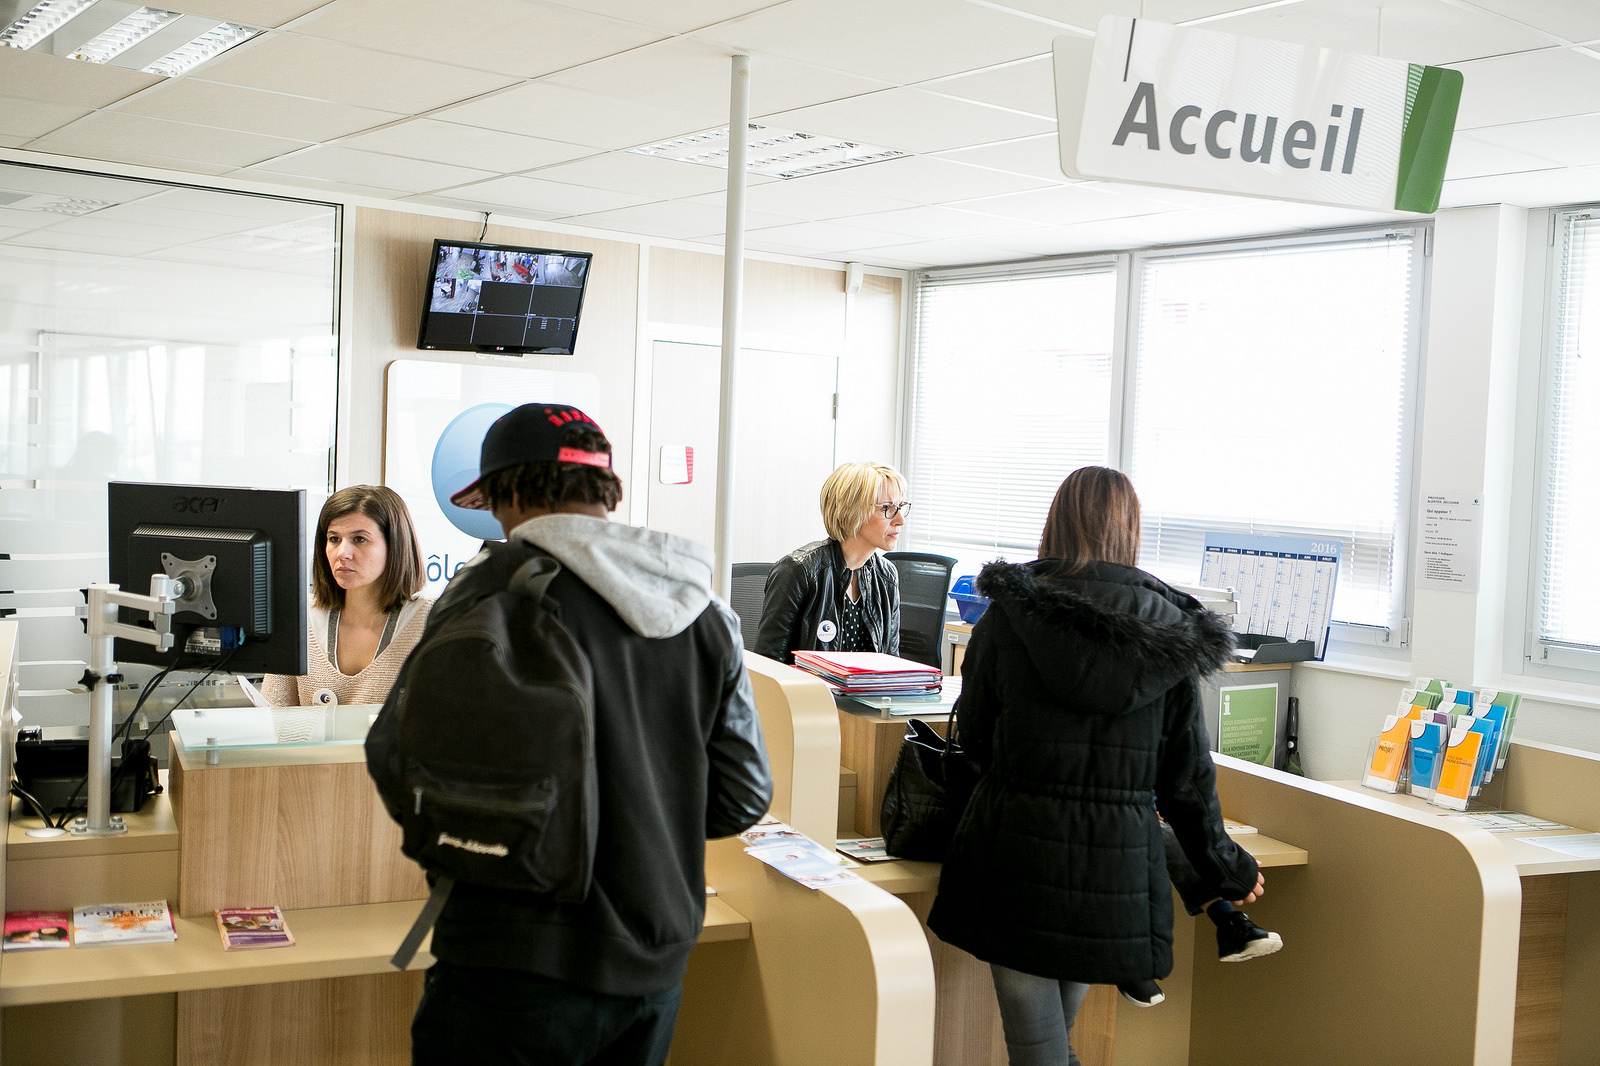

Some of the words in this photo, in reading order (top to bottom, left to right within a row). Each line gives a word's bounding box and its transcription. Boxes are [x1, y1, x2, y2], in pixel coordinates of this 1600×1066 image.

[1112, 82, 1364, 174] Accueil
[1311, 542, 1337, 554] 2016
[427, 554, 466, 582] ôl
[1379, 745, 1394, 753] PROJET
